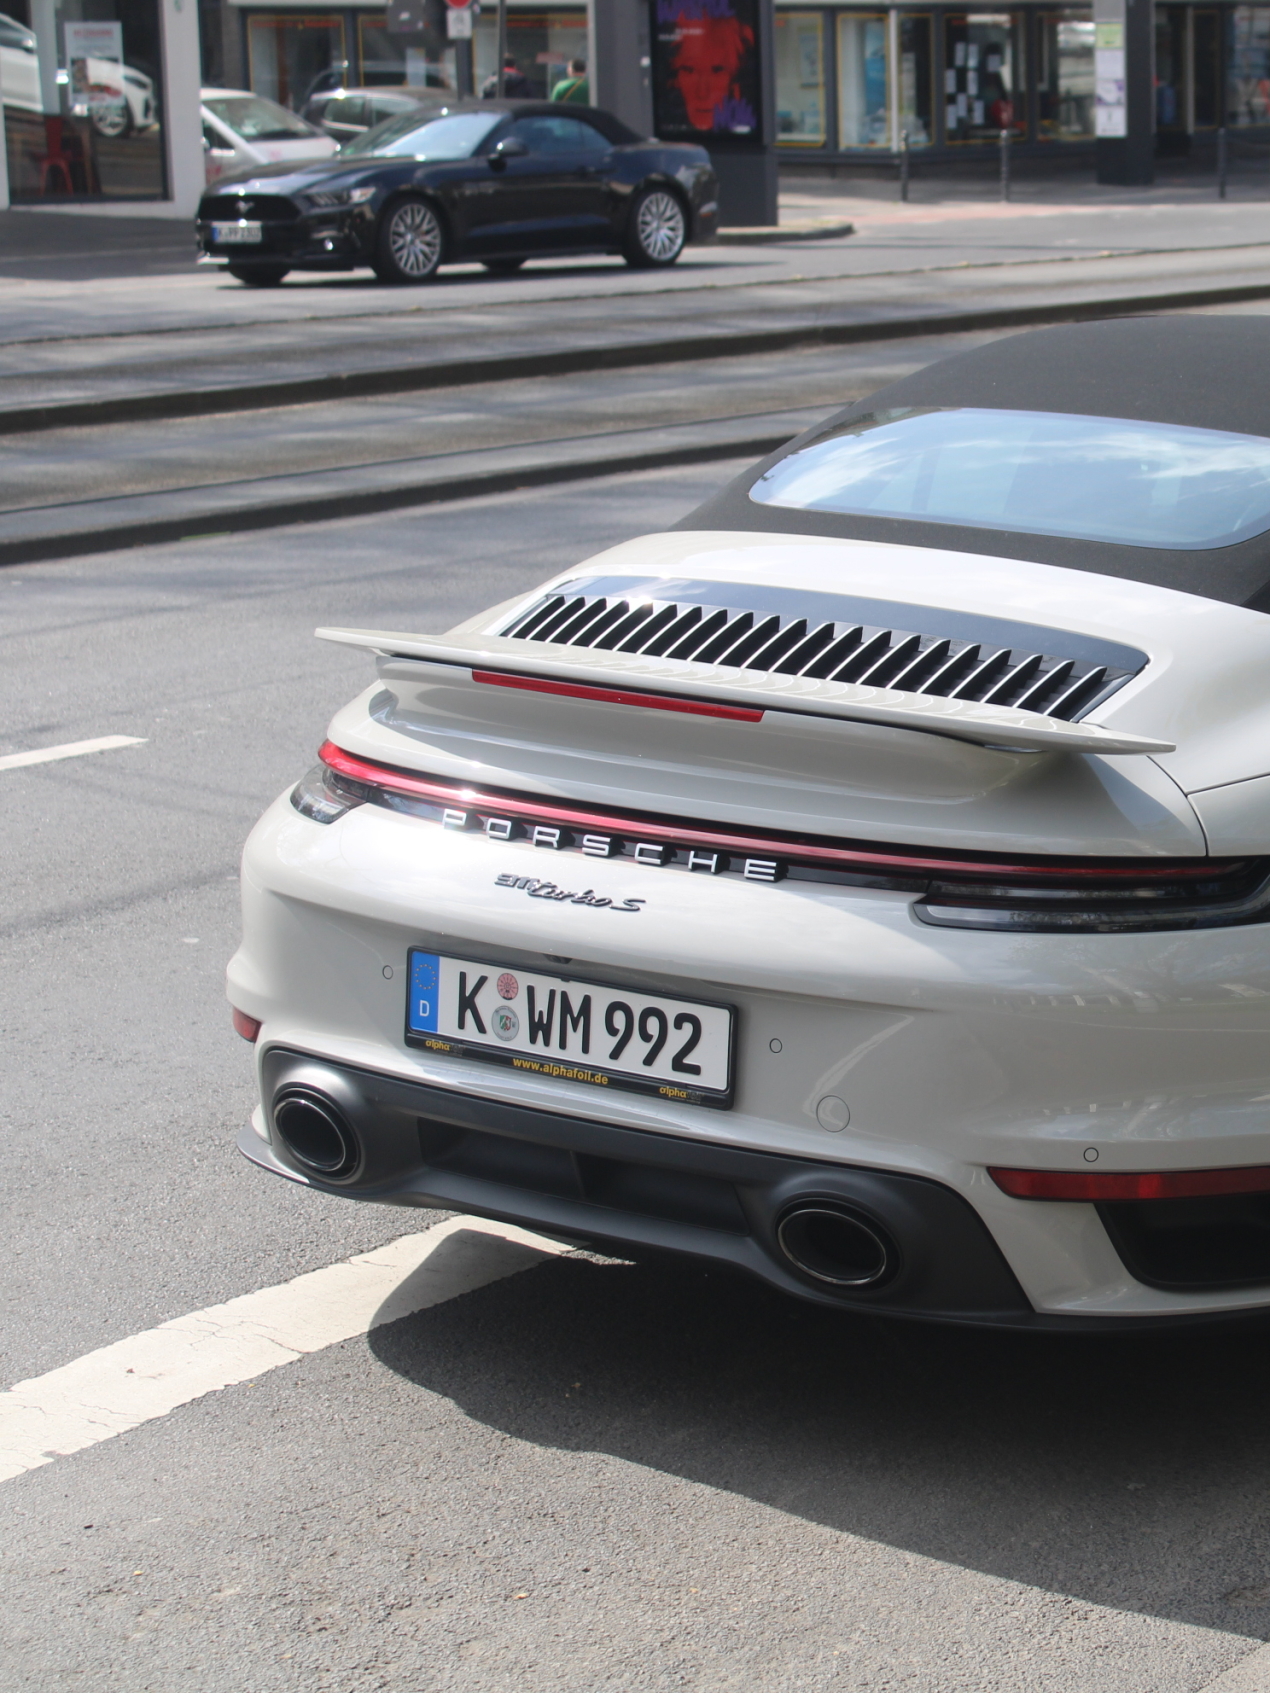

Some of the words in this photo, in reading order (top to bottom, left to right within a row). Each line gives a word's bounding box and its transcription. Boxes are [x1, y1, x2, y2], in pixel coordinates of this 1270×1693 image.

[443, 808, 777, 882] PORSCHE
[610, 898, 647, 912] S
[419, 1000, 430, 1017] D
[458, 971, 488, 1034] K
[527, 984, 592, 1055] WM
[605, 1001, 702, 1076] 992
[513, 1058, 608, 1085] www.alphafoil.de
